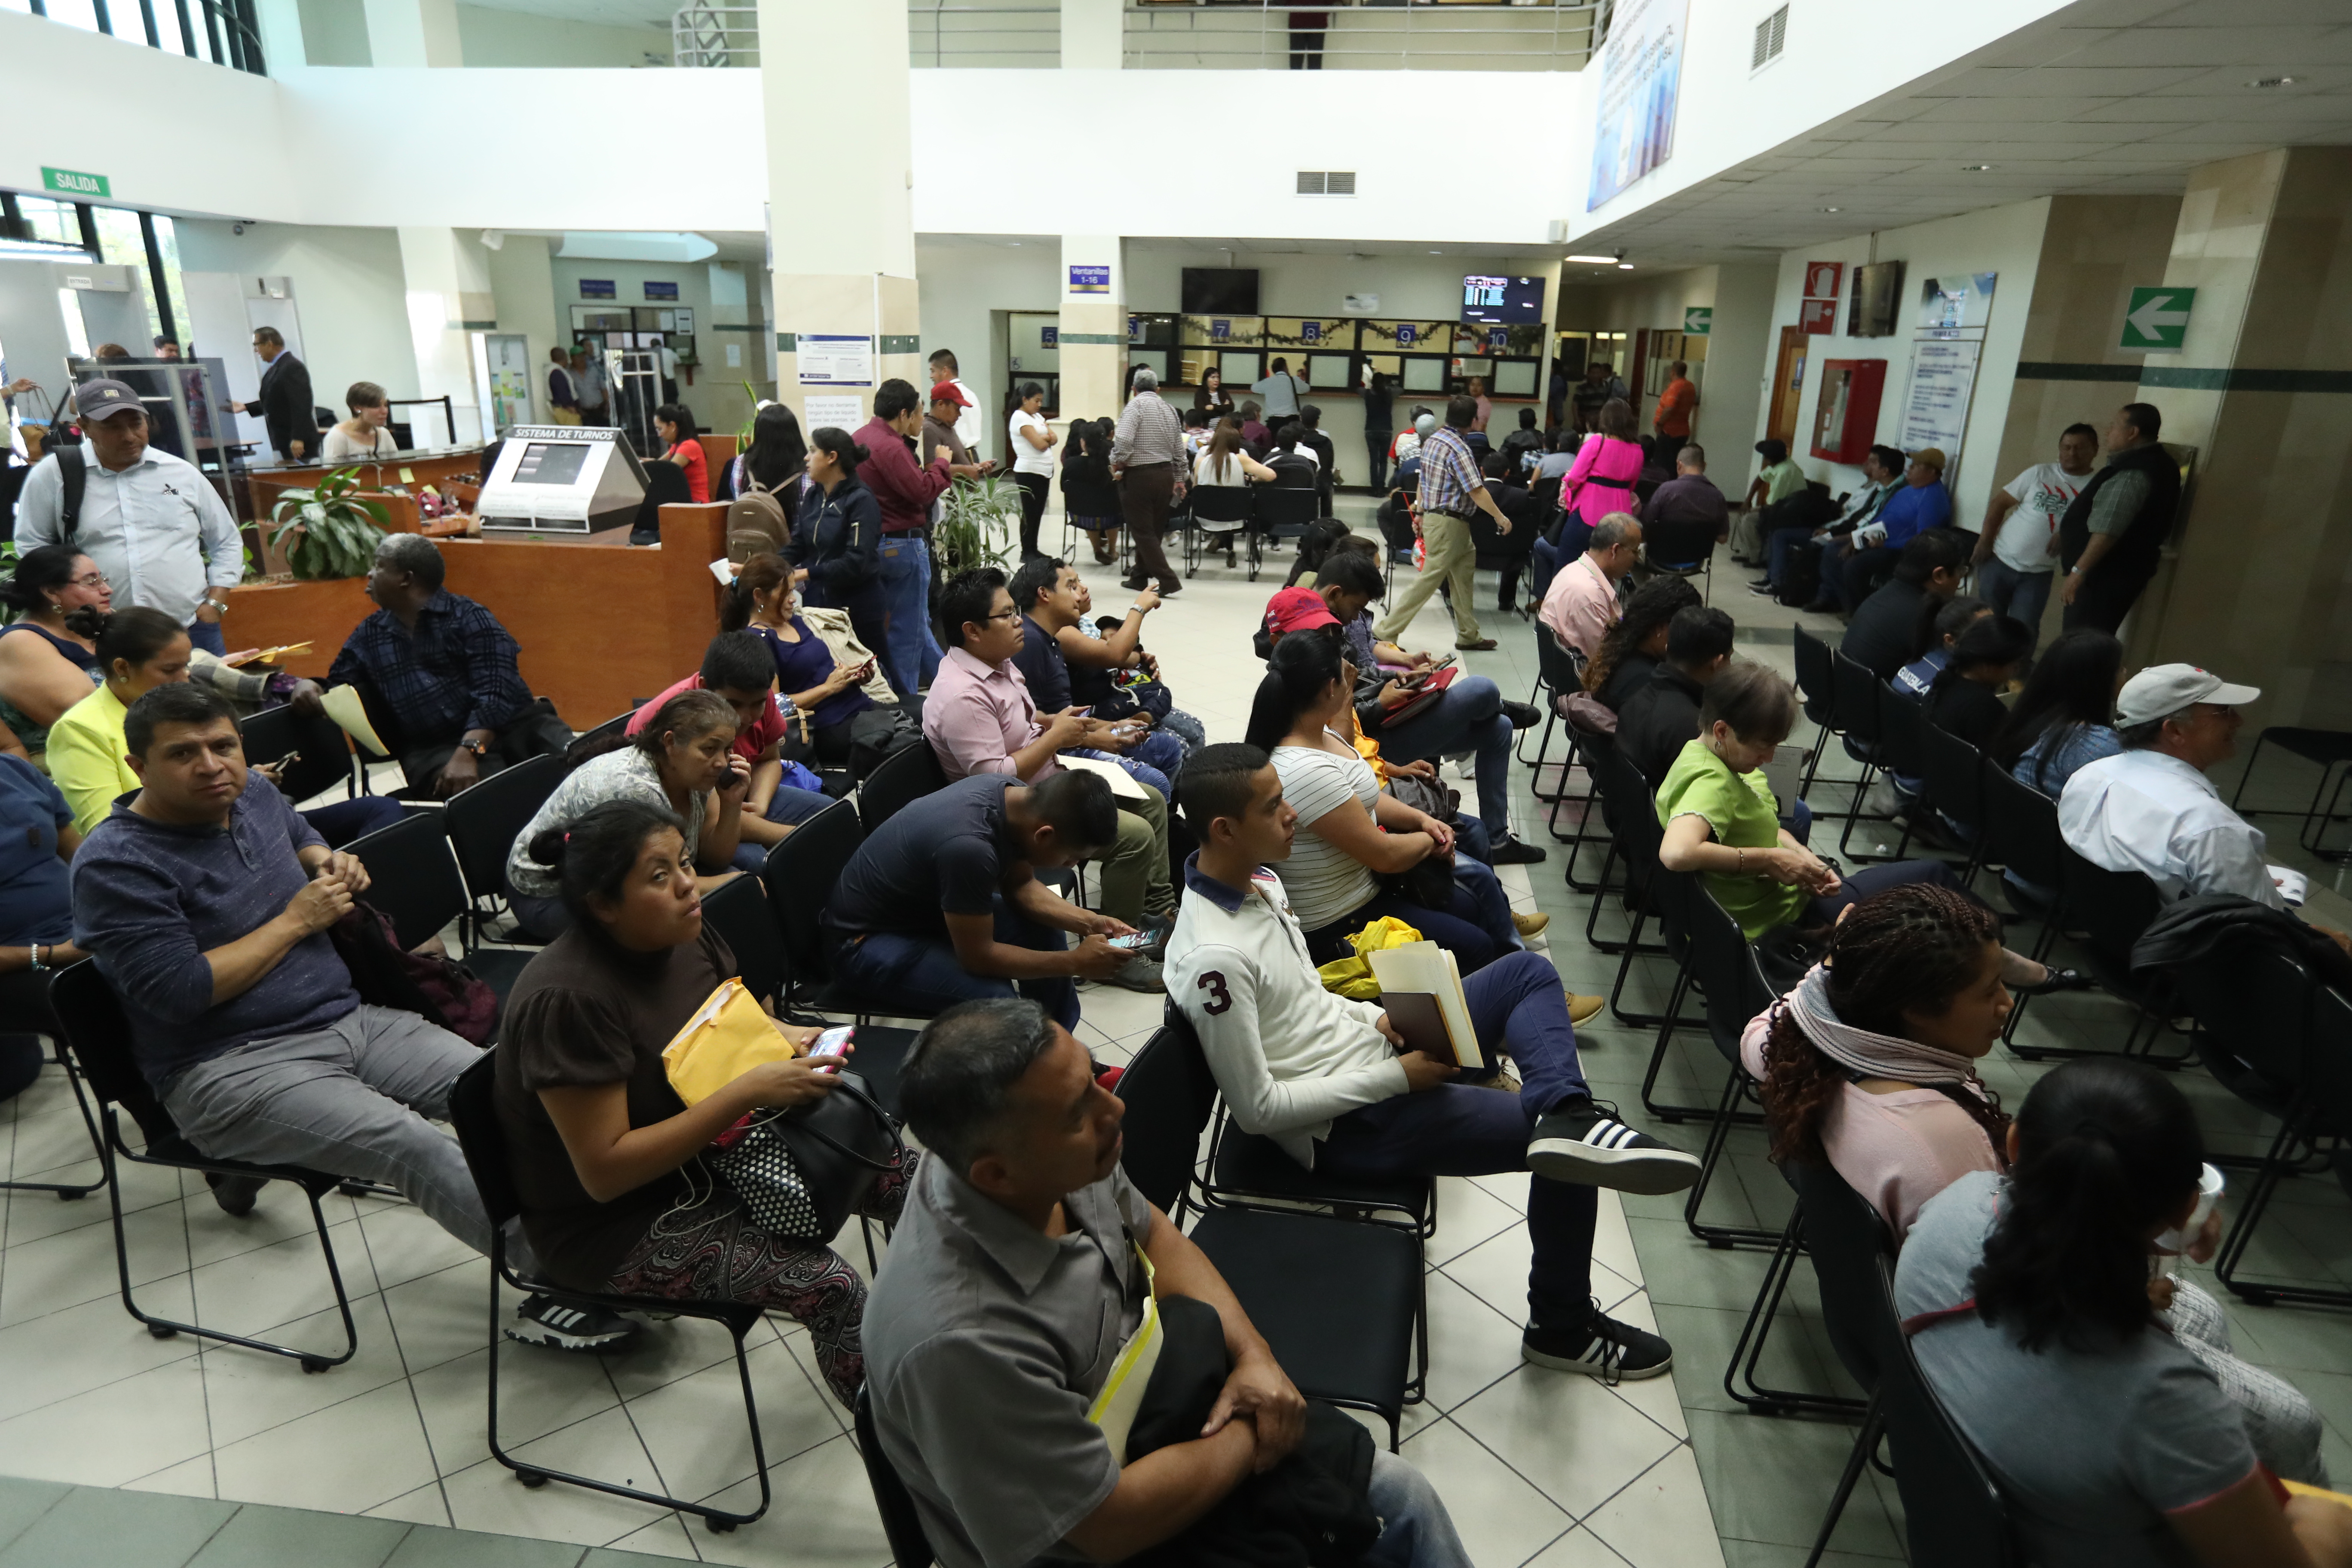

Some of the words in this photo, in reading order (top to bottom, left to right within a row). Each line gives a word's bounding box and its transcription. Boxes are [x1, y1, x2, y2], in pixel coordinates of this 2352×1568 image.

[56, 172, 101, 193] SALIDA
[1071, 267, 1109, 275] Ventanillas
[1045, 332, 1053, 345] 5
[1216, 325, 1225, 339] 7
[1306, 328, 1315, 342] 8
[1400, 331, 1411, 344] 9
[1489, 334, 1507, 347] 10
[515, 429, 556, 439] SISTEMA
[558, 430, 573, 439] DE
[573, 431, 614, 440] TURNOS
[1197, 970, 1232, 1016] 3
